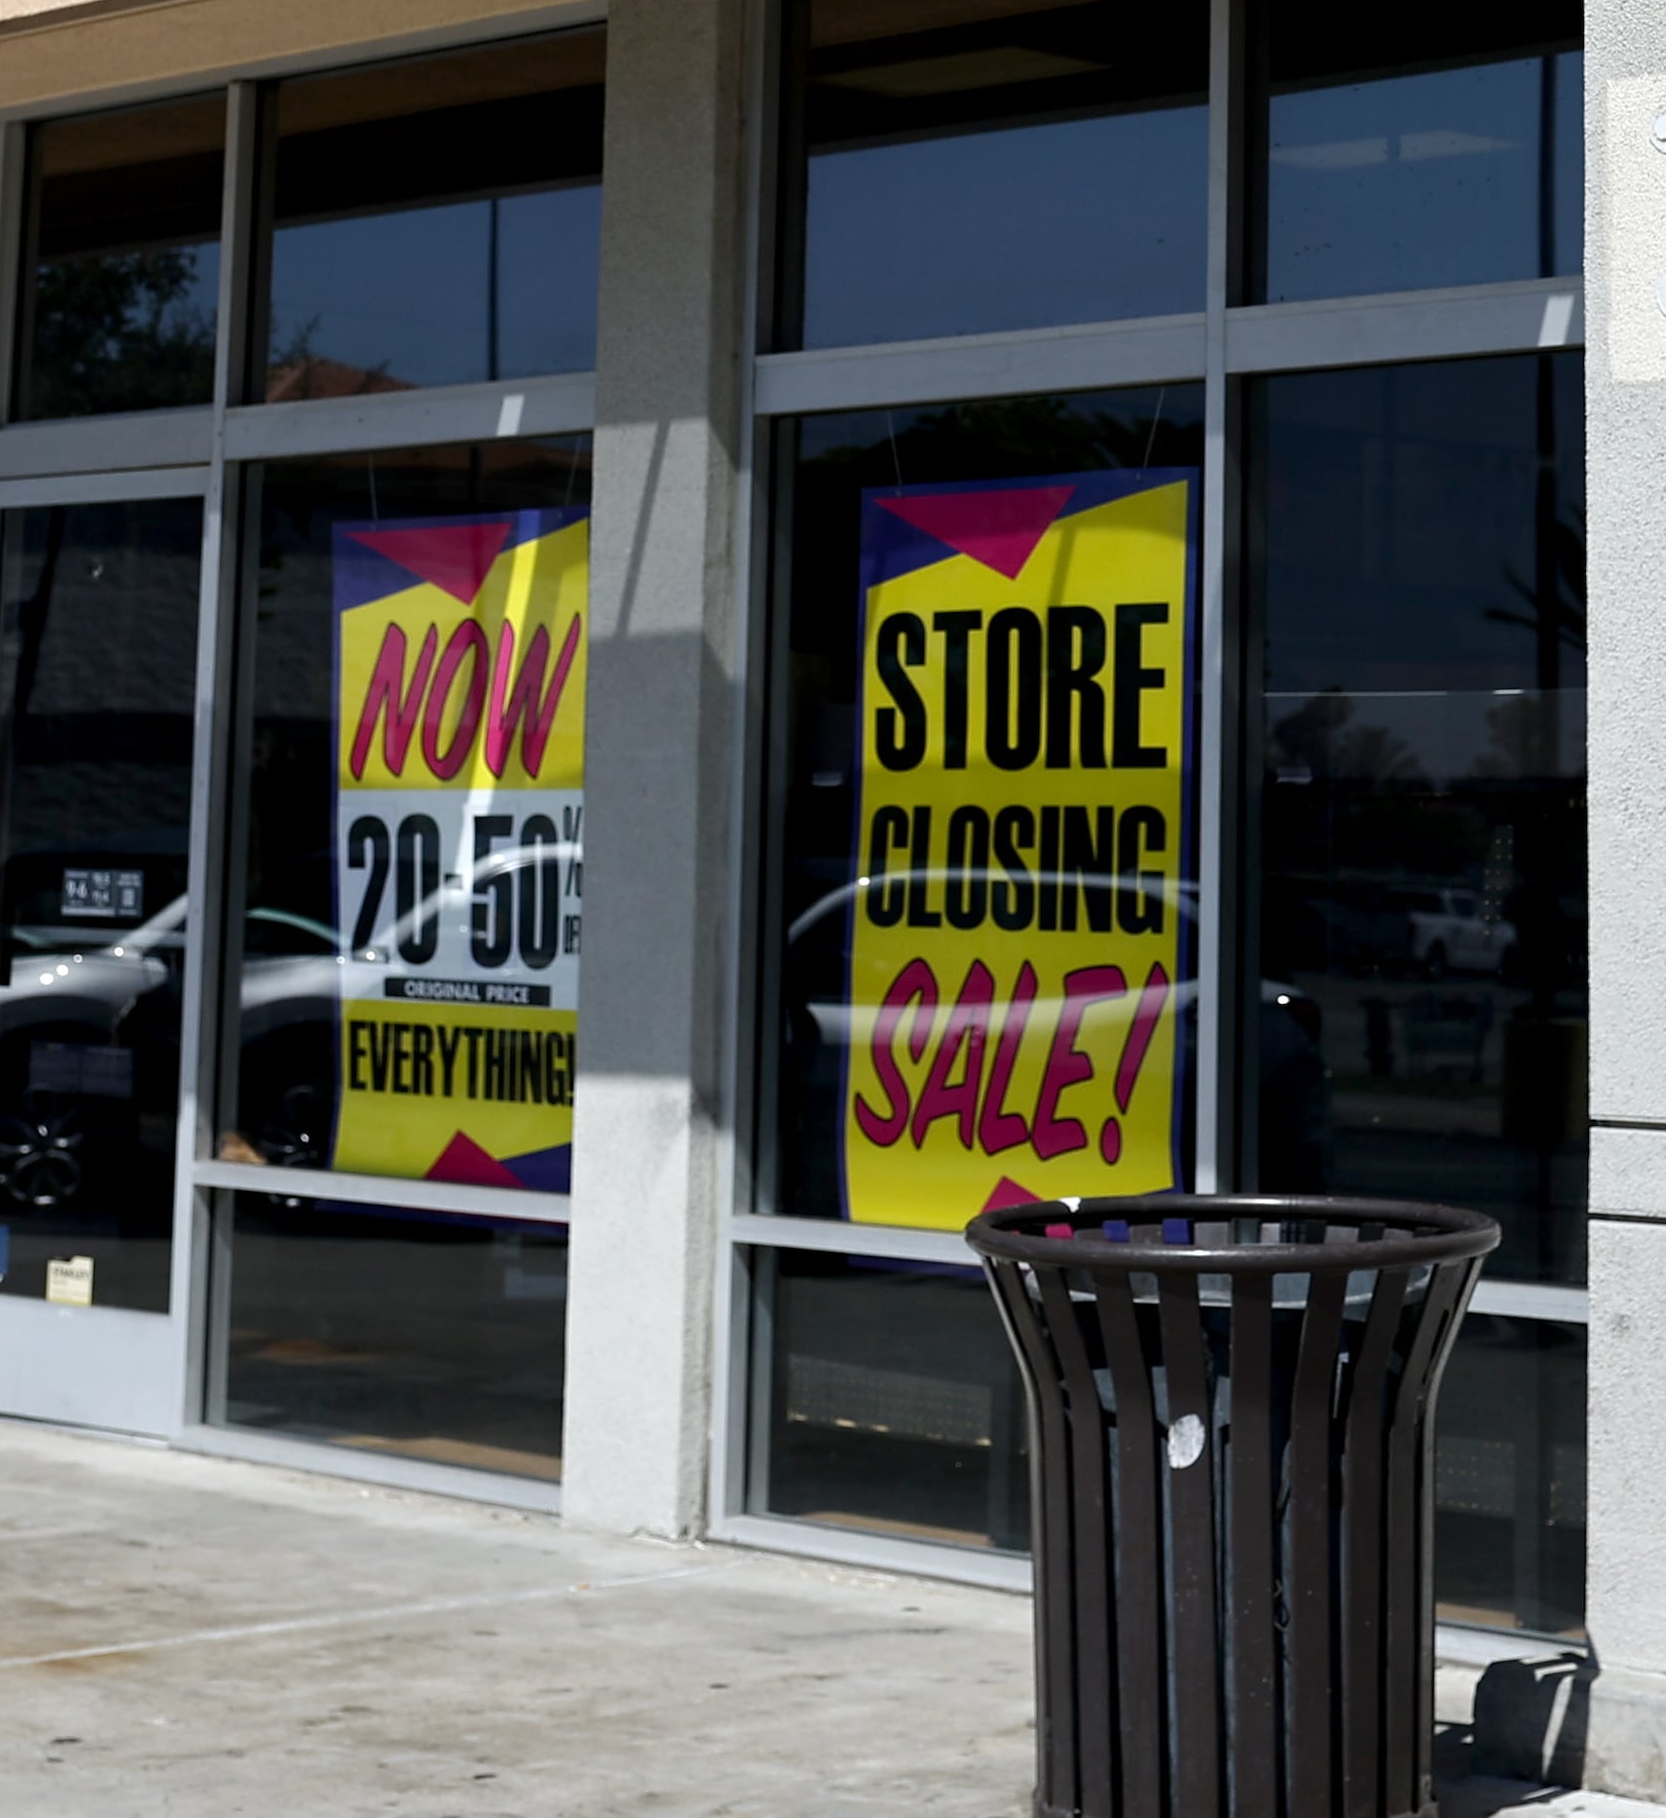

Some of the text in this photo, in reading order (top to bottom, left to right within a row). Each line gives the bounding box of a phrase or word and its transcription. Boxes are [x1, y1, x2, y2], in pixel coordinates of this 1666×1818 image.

[349, 612, 581, 782] NOW
[875, 603, 1170, 773] STORE
[865, 803, 1166, 936] CLOSING
[403, 979, 530, 1005] ORIGINAL PRICE
[854, 957, 1170, 1166] SALE!
